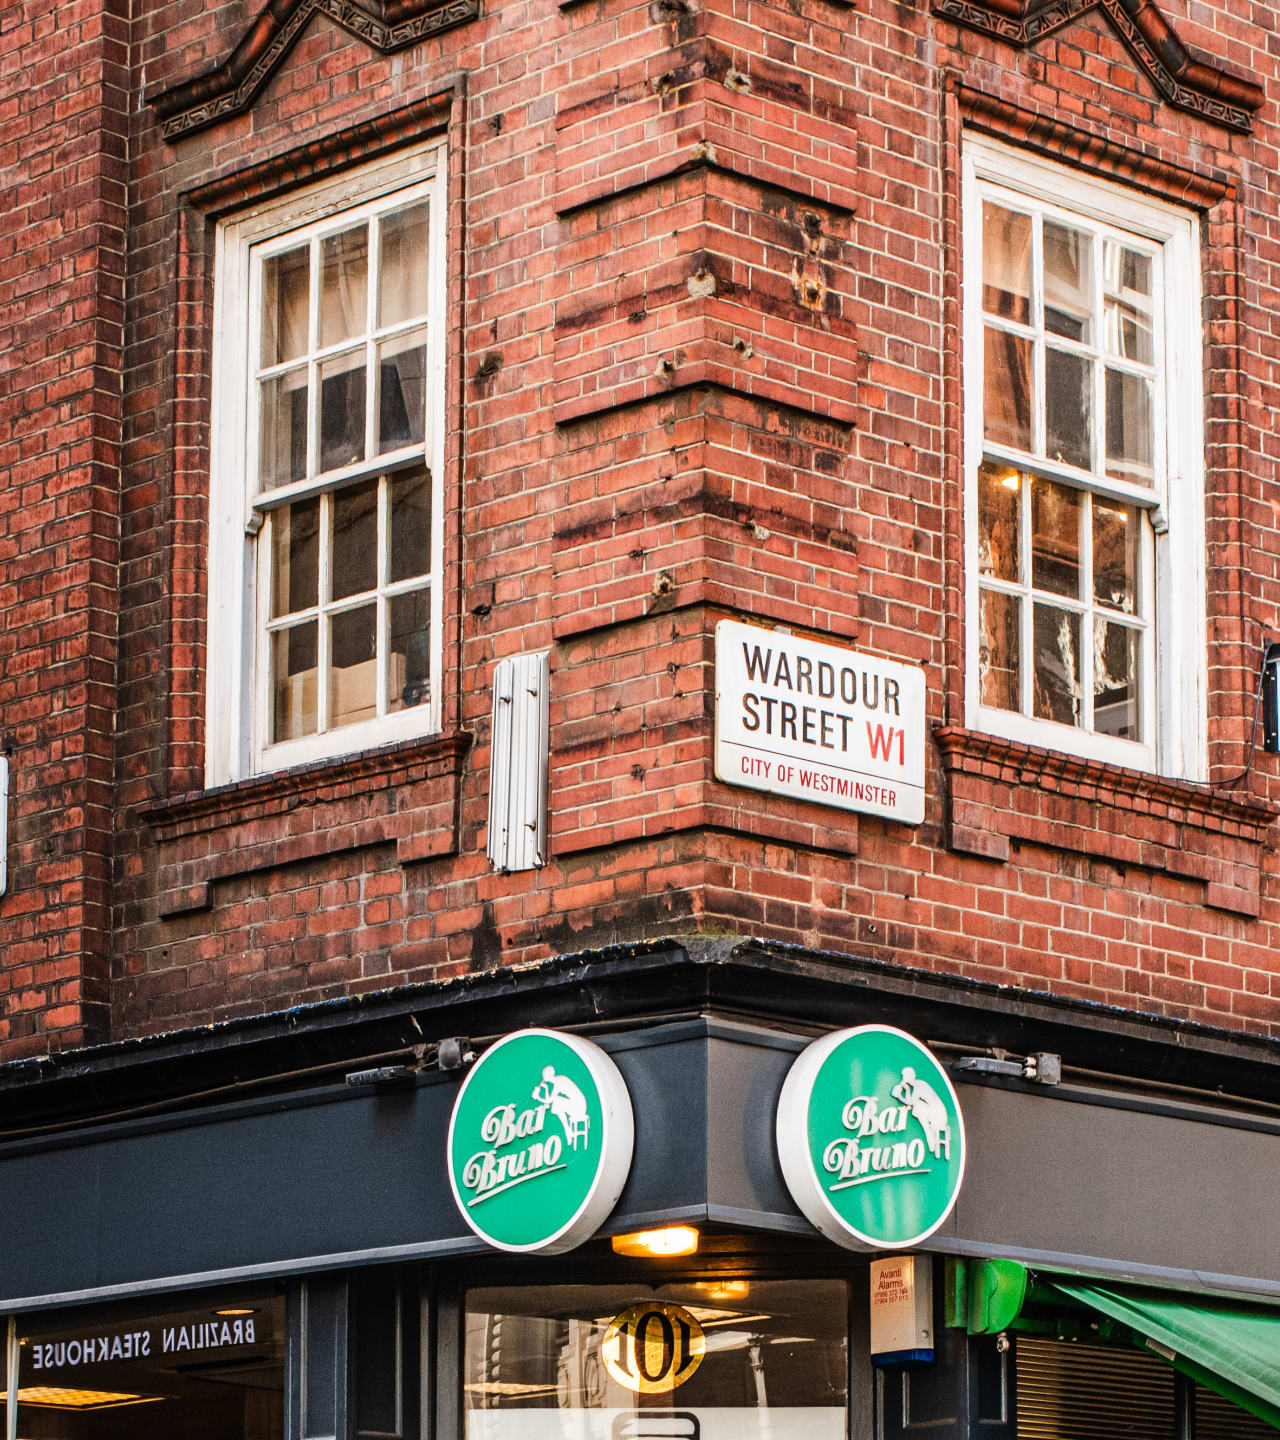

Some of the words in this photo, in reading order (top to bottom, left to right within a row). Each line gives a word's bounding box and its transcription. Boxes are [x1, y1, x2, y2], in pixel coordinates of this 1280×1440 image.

[742, 642, 900, 716] WARDOUR
[742, 692, 854, 752] STREET
[866, 721, 904, 766] W1
[741, 756, 772, 779] CITY
[777, 764, 794, 783] OF
[799, 768, 896, 807] WESTMINSTER
[481, 1103, 550, 1149] Bar
[841, 1095, 912, 1138] Bar
[463, 1135, 562, 1195] Bruno
[823, 1138, 925, 1180] Bruno
[878, 1280, 903, 1290] Alarms
[880, 1268, 902, 1280] Avanti
[610, 1311, 695, 1382] 101
